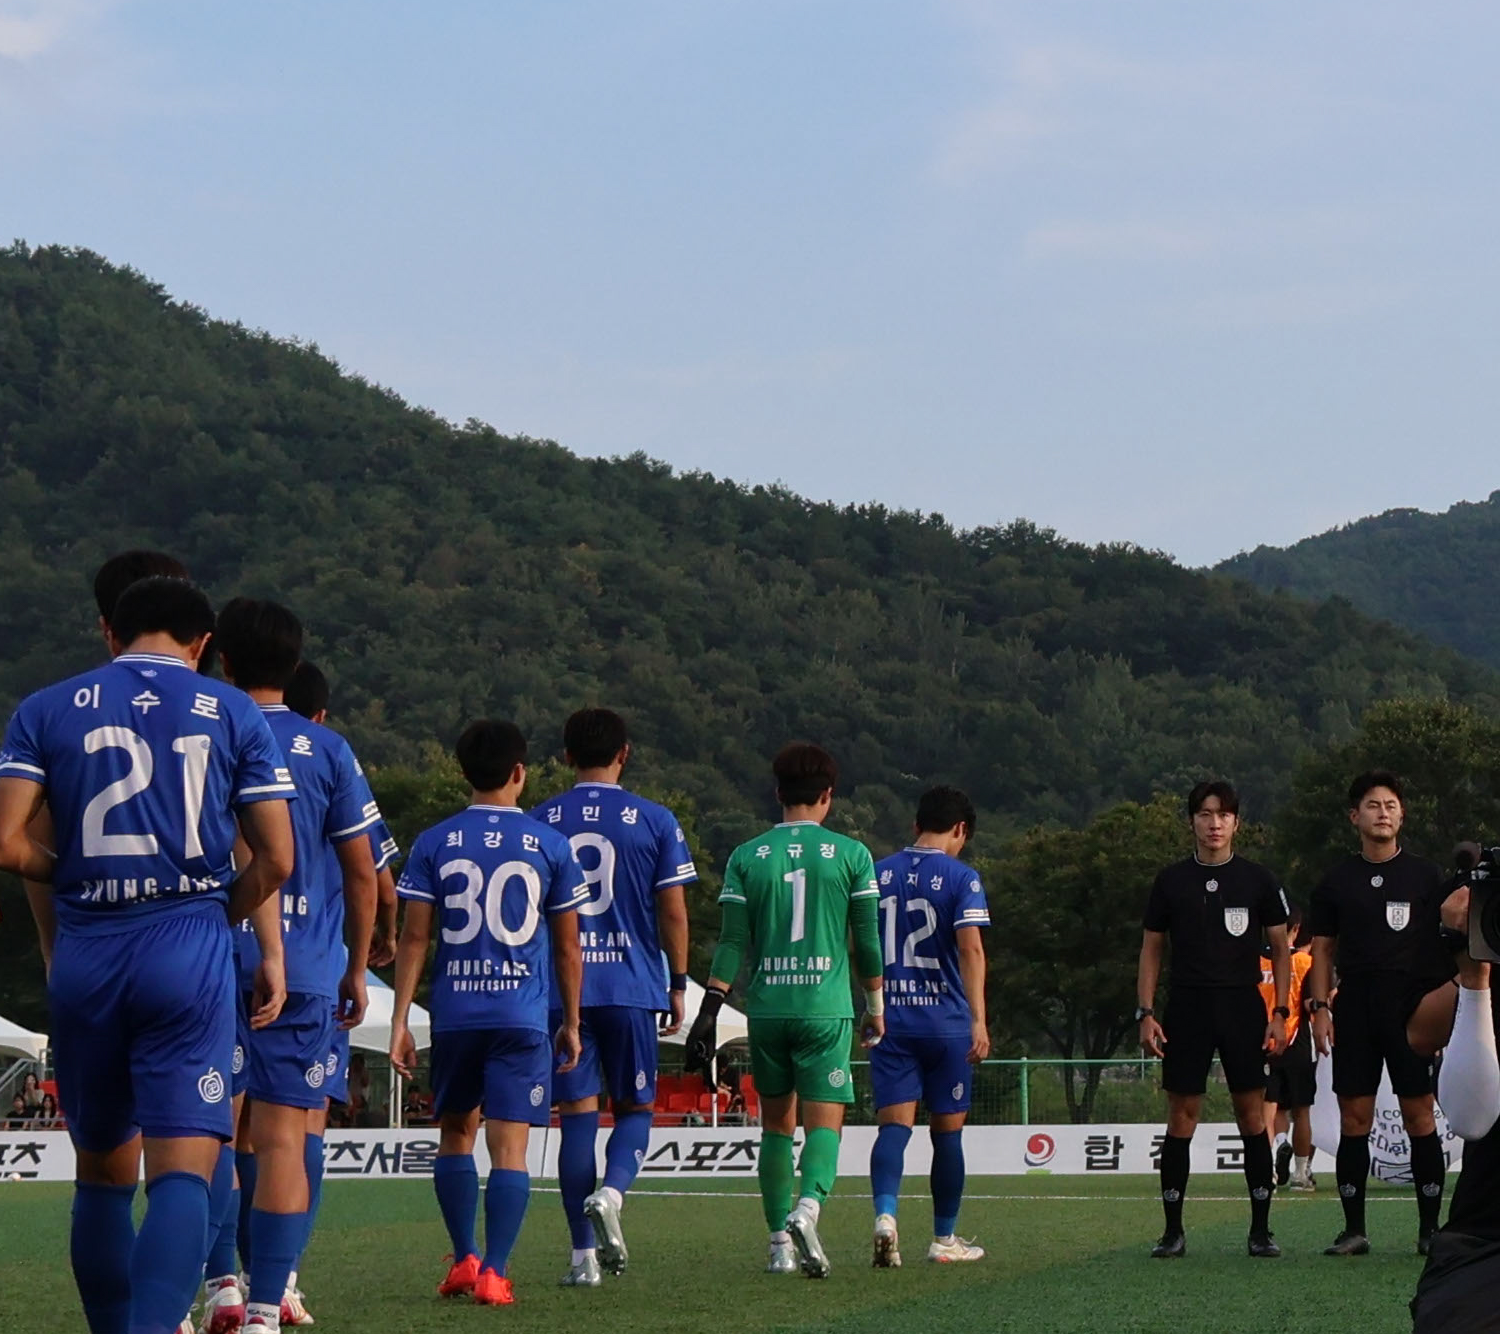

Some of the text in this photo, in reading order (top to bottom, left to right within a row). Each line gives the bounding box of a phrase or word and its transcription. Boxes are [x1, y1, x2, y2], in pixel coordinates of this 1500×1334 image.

[82, 725, 211, 859] 21
[439, 858, 542, 946] 30
[569, 832, 616, 917] 9
[784, 868, 806, 943] 1
[879, 895, 941, 969] 12
[323, 1140, 440, 1173] 츠서울
